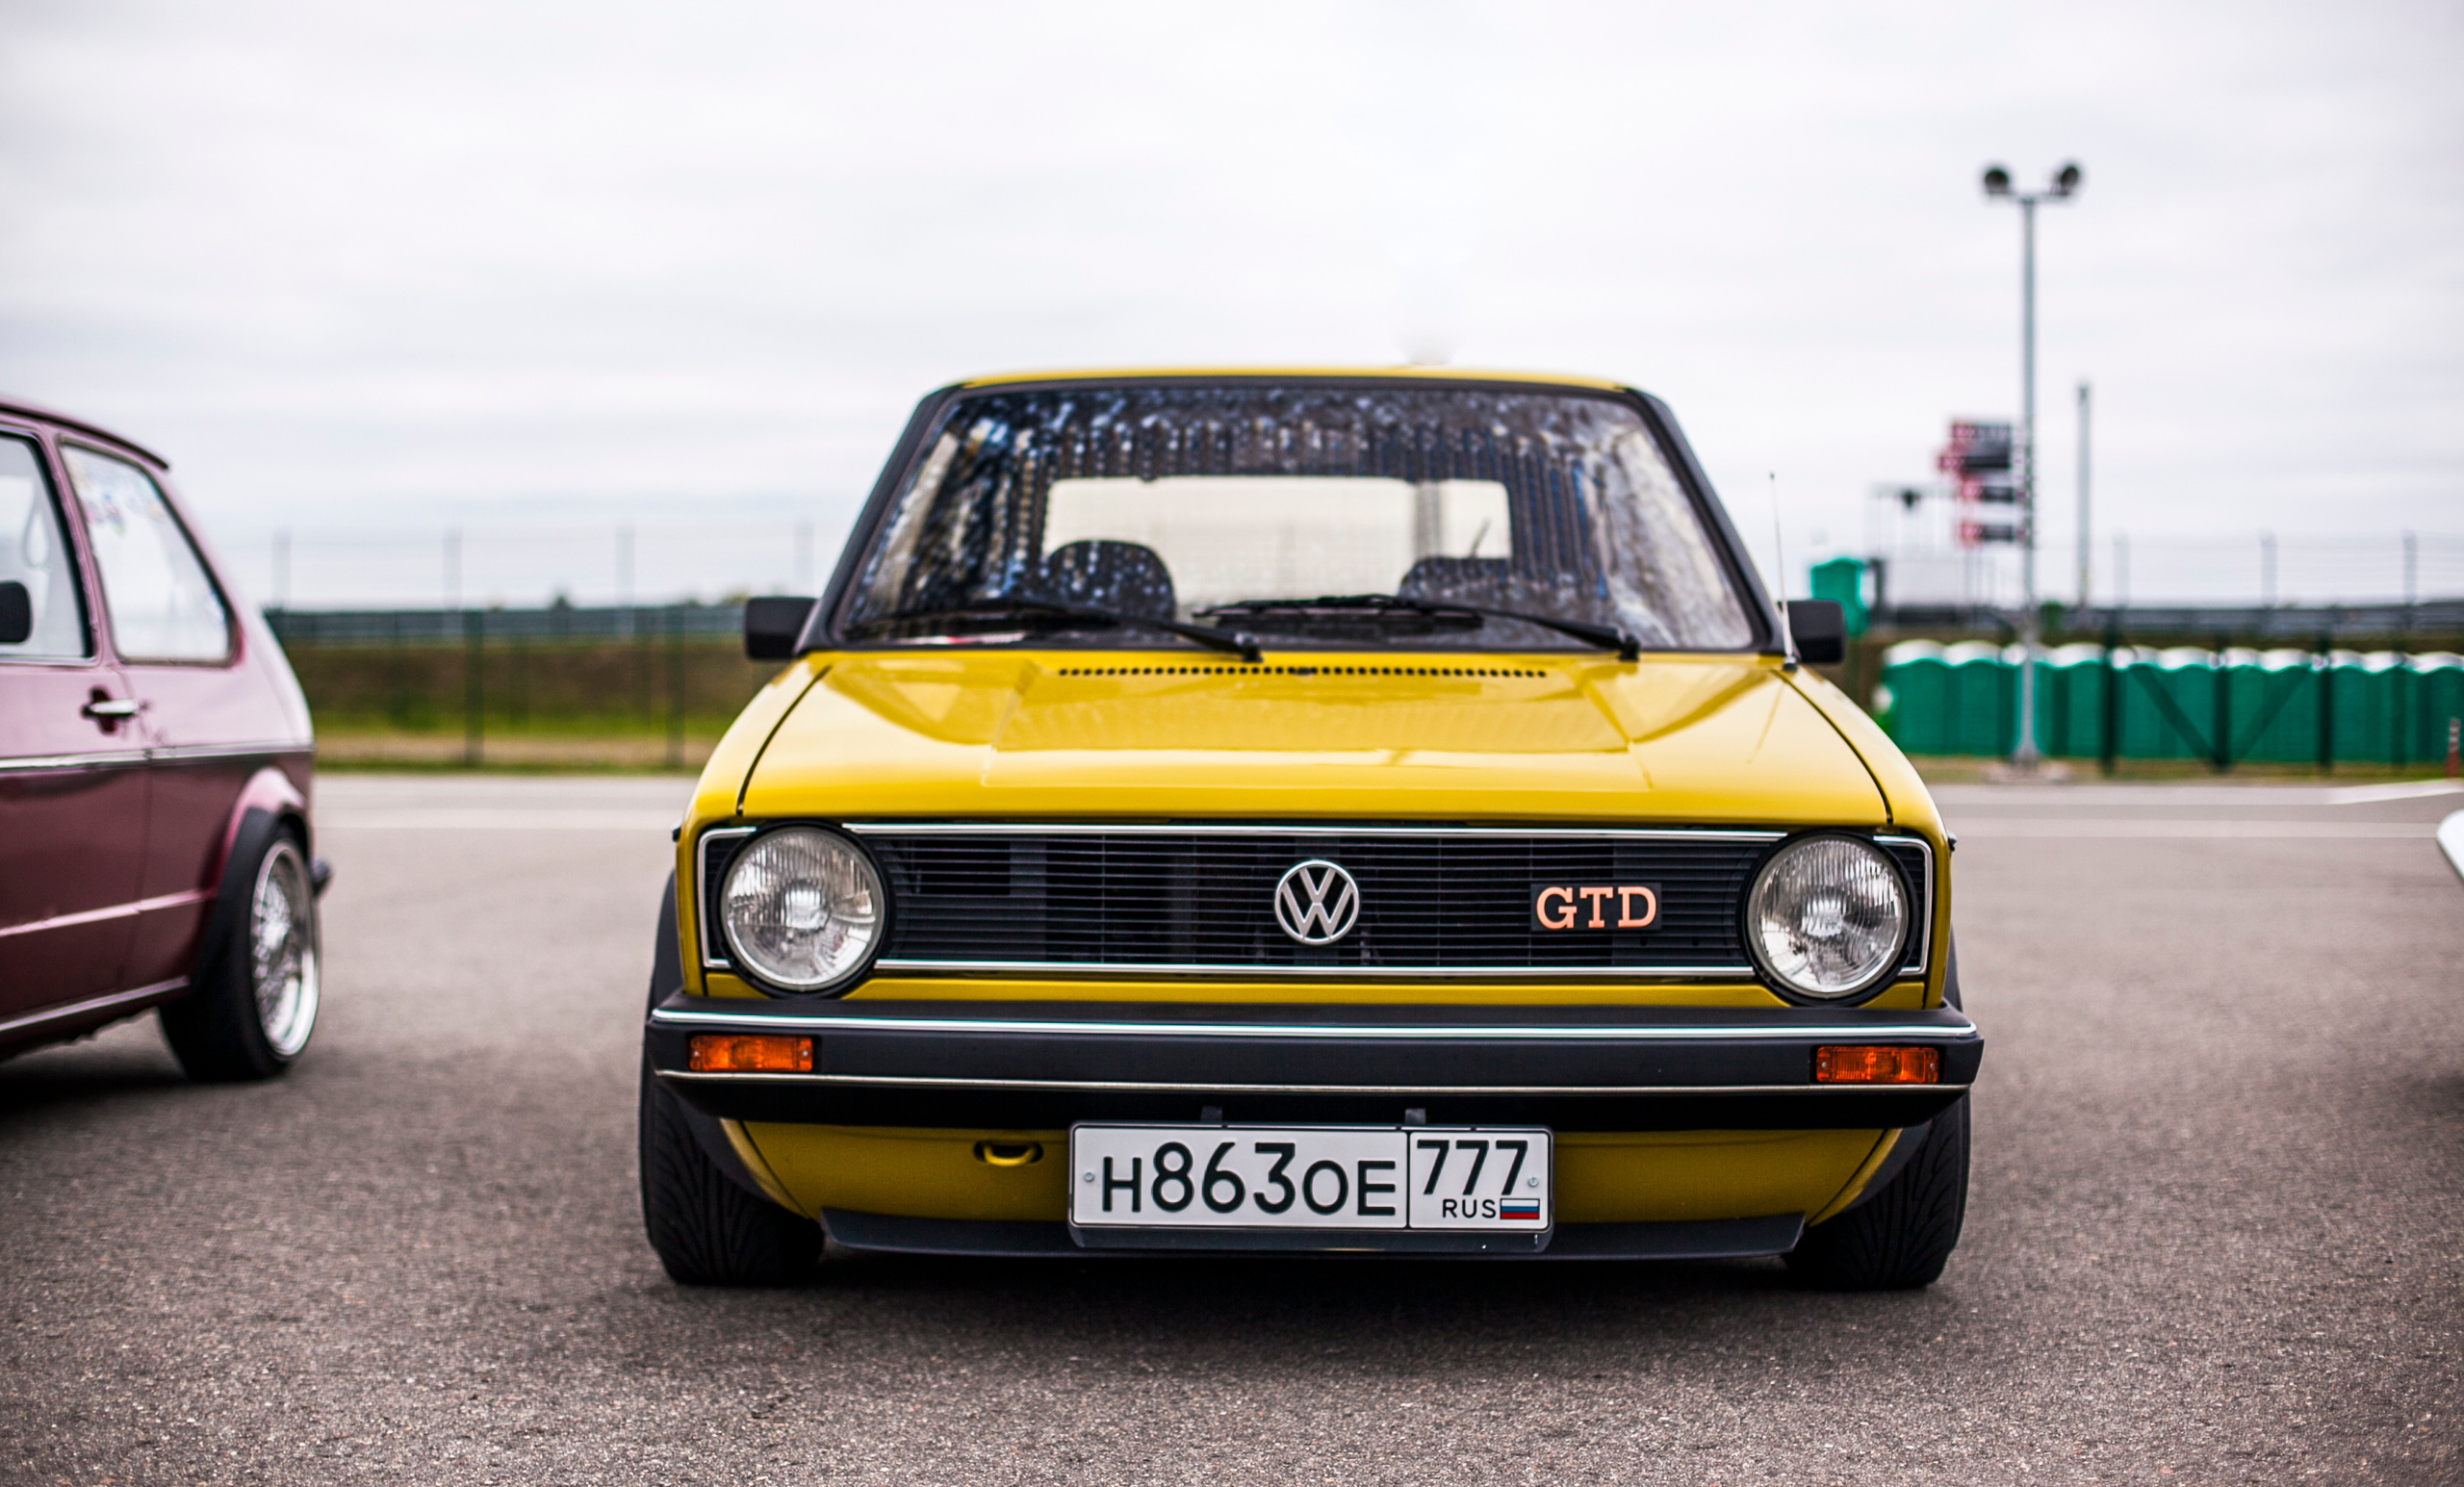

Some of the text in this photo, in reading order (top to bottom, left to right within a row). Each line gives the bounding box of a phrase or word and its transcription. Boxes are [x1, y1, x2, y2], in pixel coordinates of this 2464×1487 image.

[1274, 859, 1360, 944] VW
[1536, 885, 1657, 930] GTD
[1416, 1140, 1528, 1195] 777
[1443, 1199, 1497, 1218] RUS
